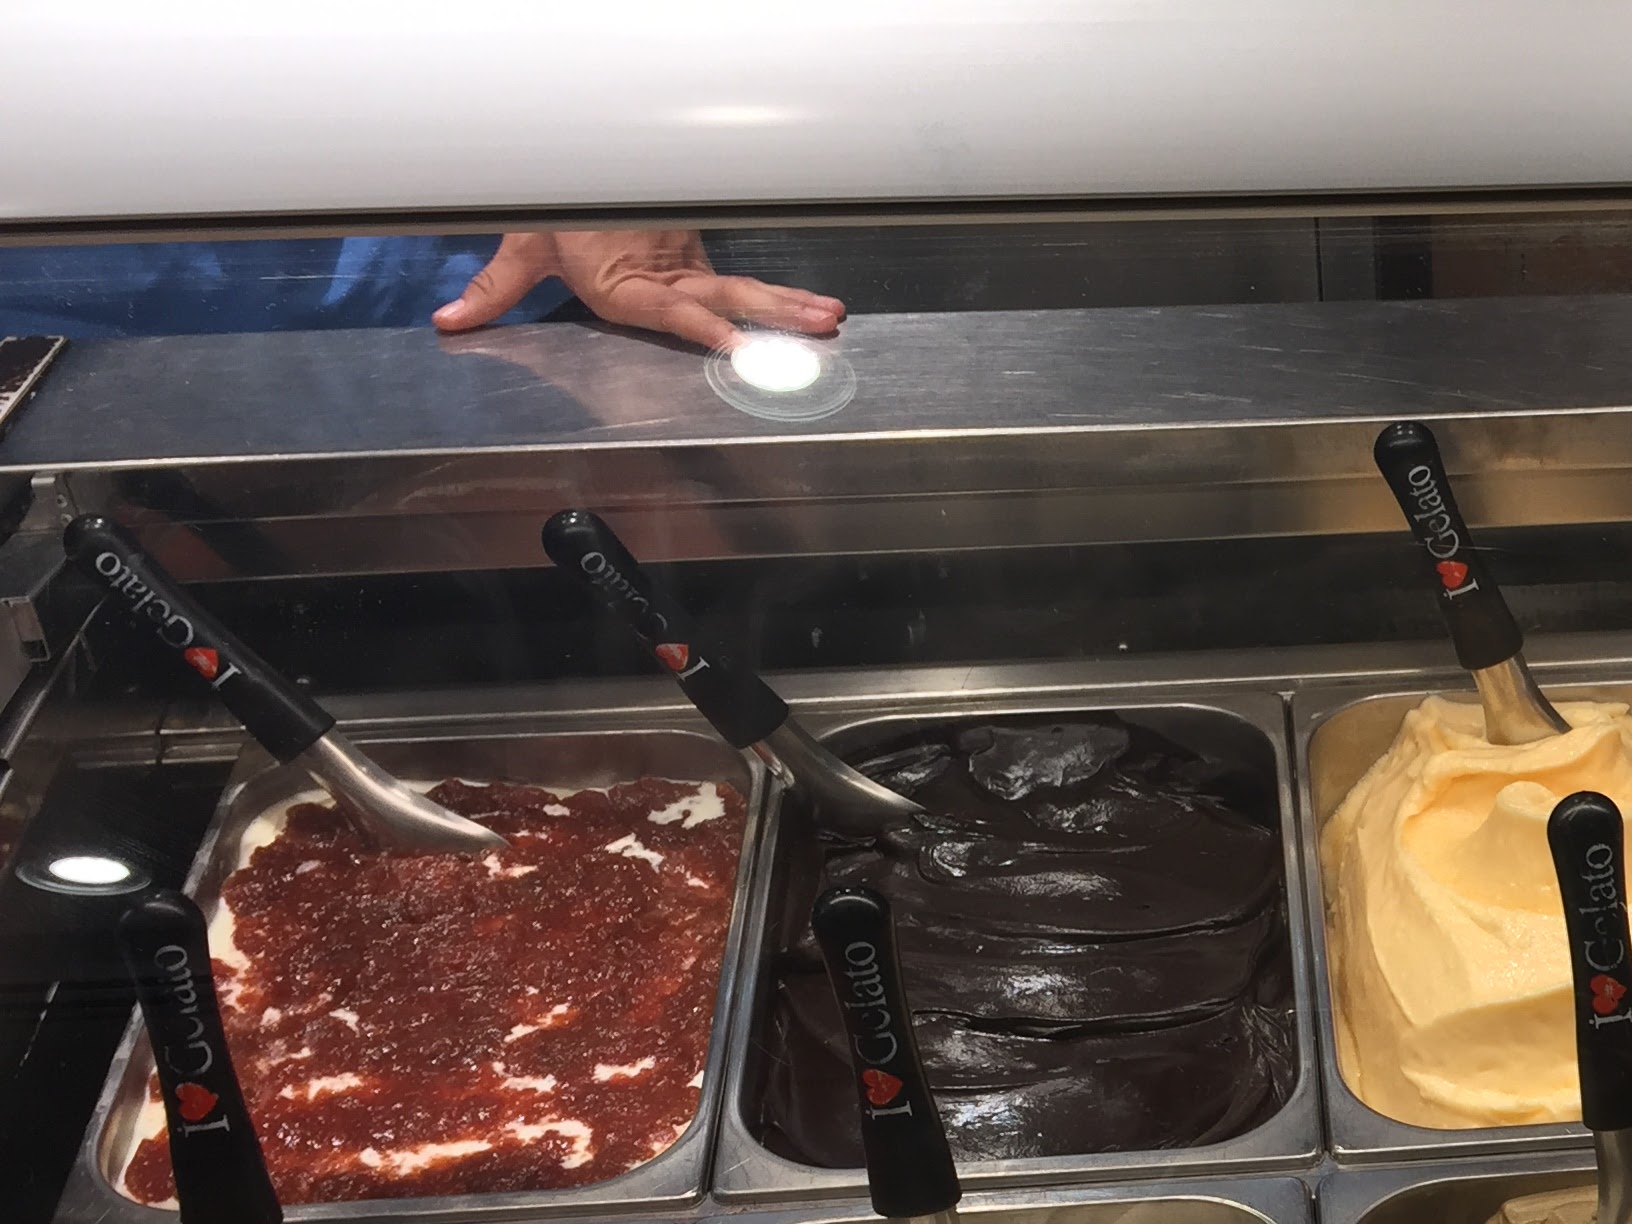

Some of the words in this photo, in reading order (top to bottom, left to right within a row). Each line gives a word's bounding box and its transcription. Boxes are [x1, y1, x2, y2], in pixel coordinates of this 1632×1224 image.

[1407, 465, 1460, 560] Gelato
[95, 551, 194, 648] Gelato
[1578, 843, 1625, 972] Gelato
[843, 941, 898, 1065] Gelato
